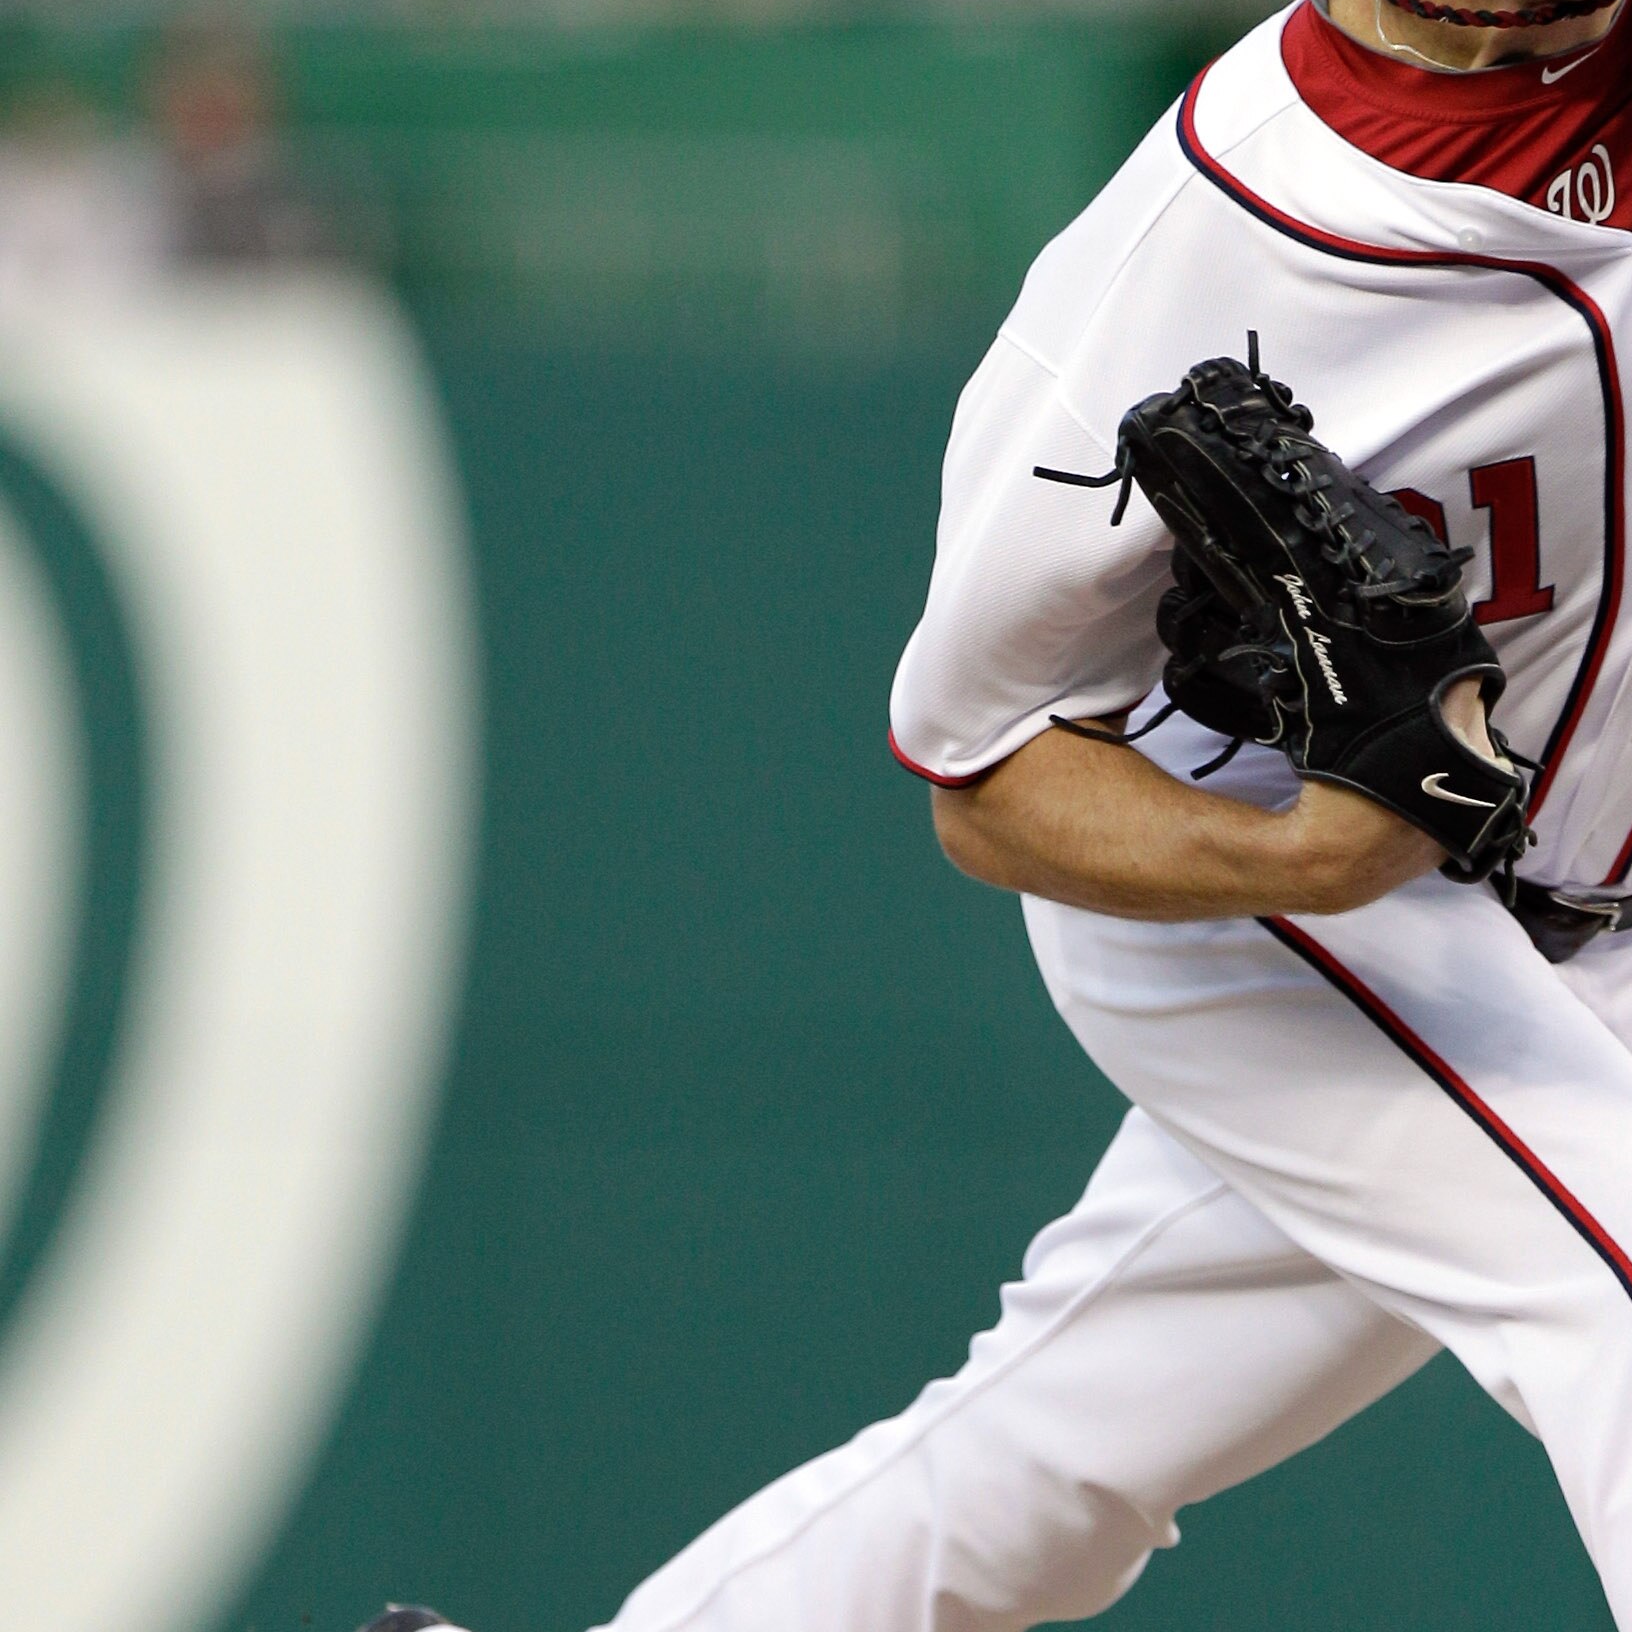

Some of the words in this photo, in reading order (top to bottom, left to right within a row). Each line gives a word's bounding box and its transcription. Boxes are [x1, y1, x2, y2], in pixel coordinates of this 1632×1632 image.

[1383, 455, 1555, 625] 1
[1273, 573, 1314, 620] John
[1303, 626, 1347, 706] Lannan
